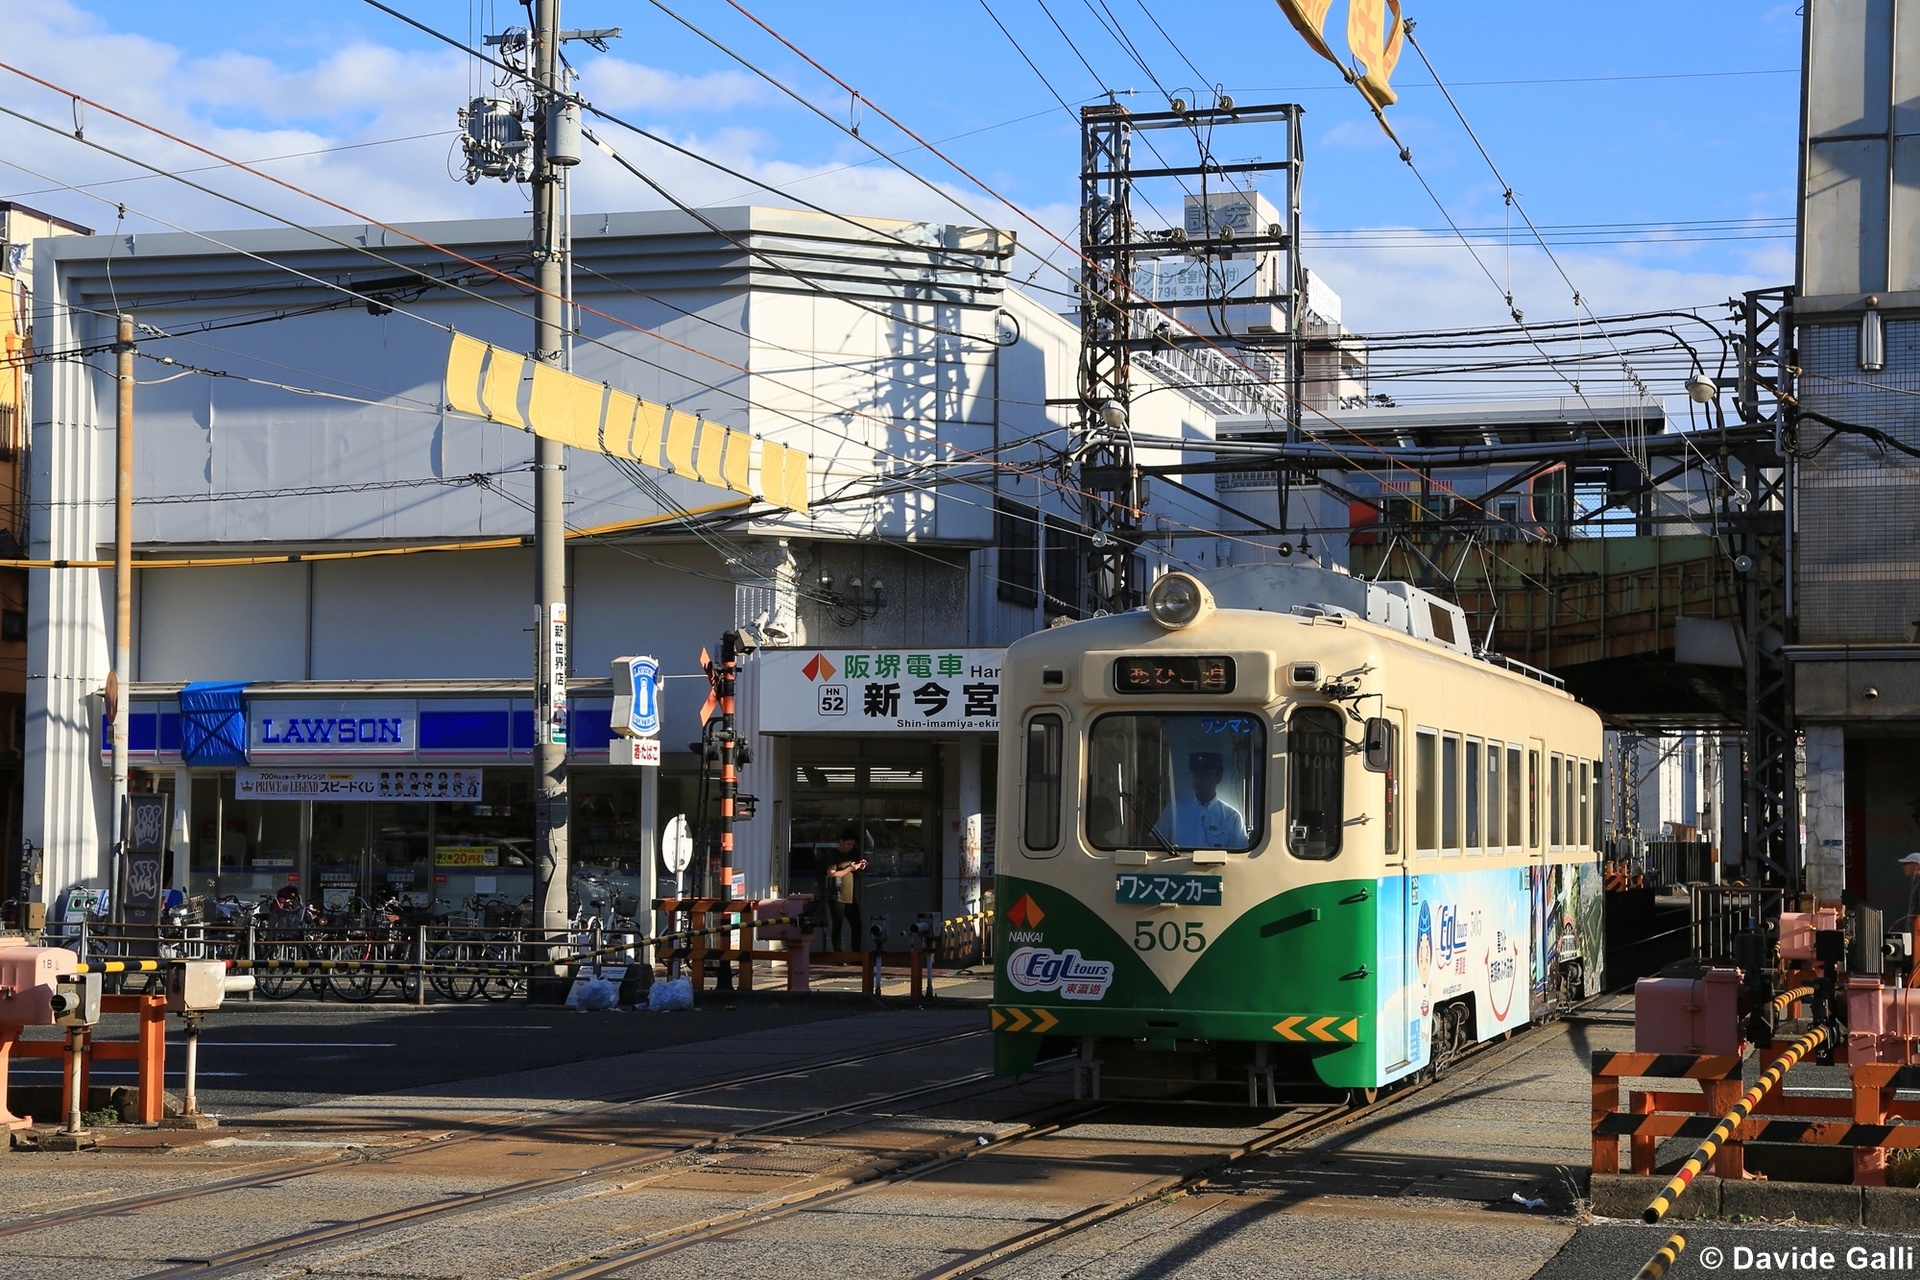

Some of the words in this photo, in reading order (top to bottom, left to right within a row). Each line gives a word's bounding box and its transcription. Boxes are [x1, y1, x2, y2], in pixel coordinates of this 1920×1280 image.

[555, 624, 564, 685] 新世界店
[844, 653, 963, 679] 阪堺電車
[822, 697, 844, 711] 52
[864, 682, 999, 717] 新今宮
[263, 719, 403, 743] LAWSON
[255, 781, 281, 793] PRINCE
[290, 781, 318, 793] LEGEND
[320, 781, 374, 793] スピードくじ
[1121, 876, 1217, 901] ワンマンカー
[1009, 931, 1043, 942] NANKAI
[1134, 921, 1206, 953] 505
[1073, 963, 1109, 974] tours
